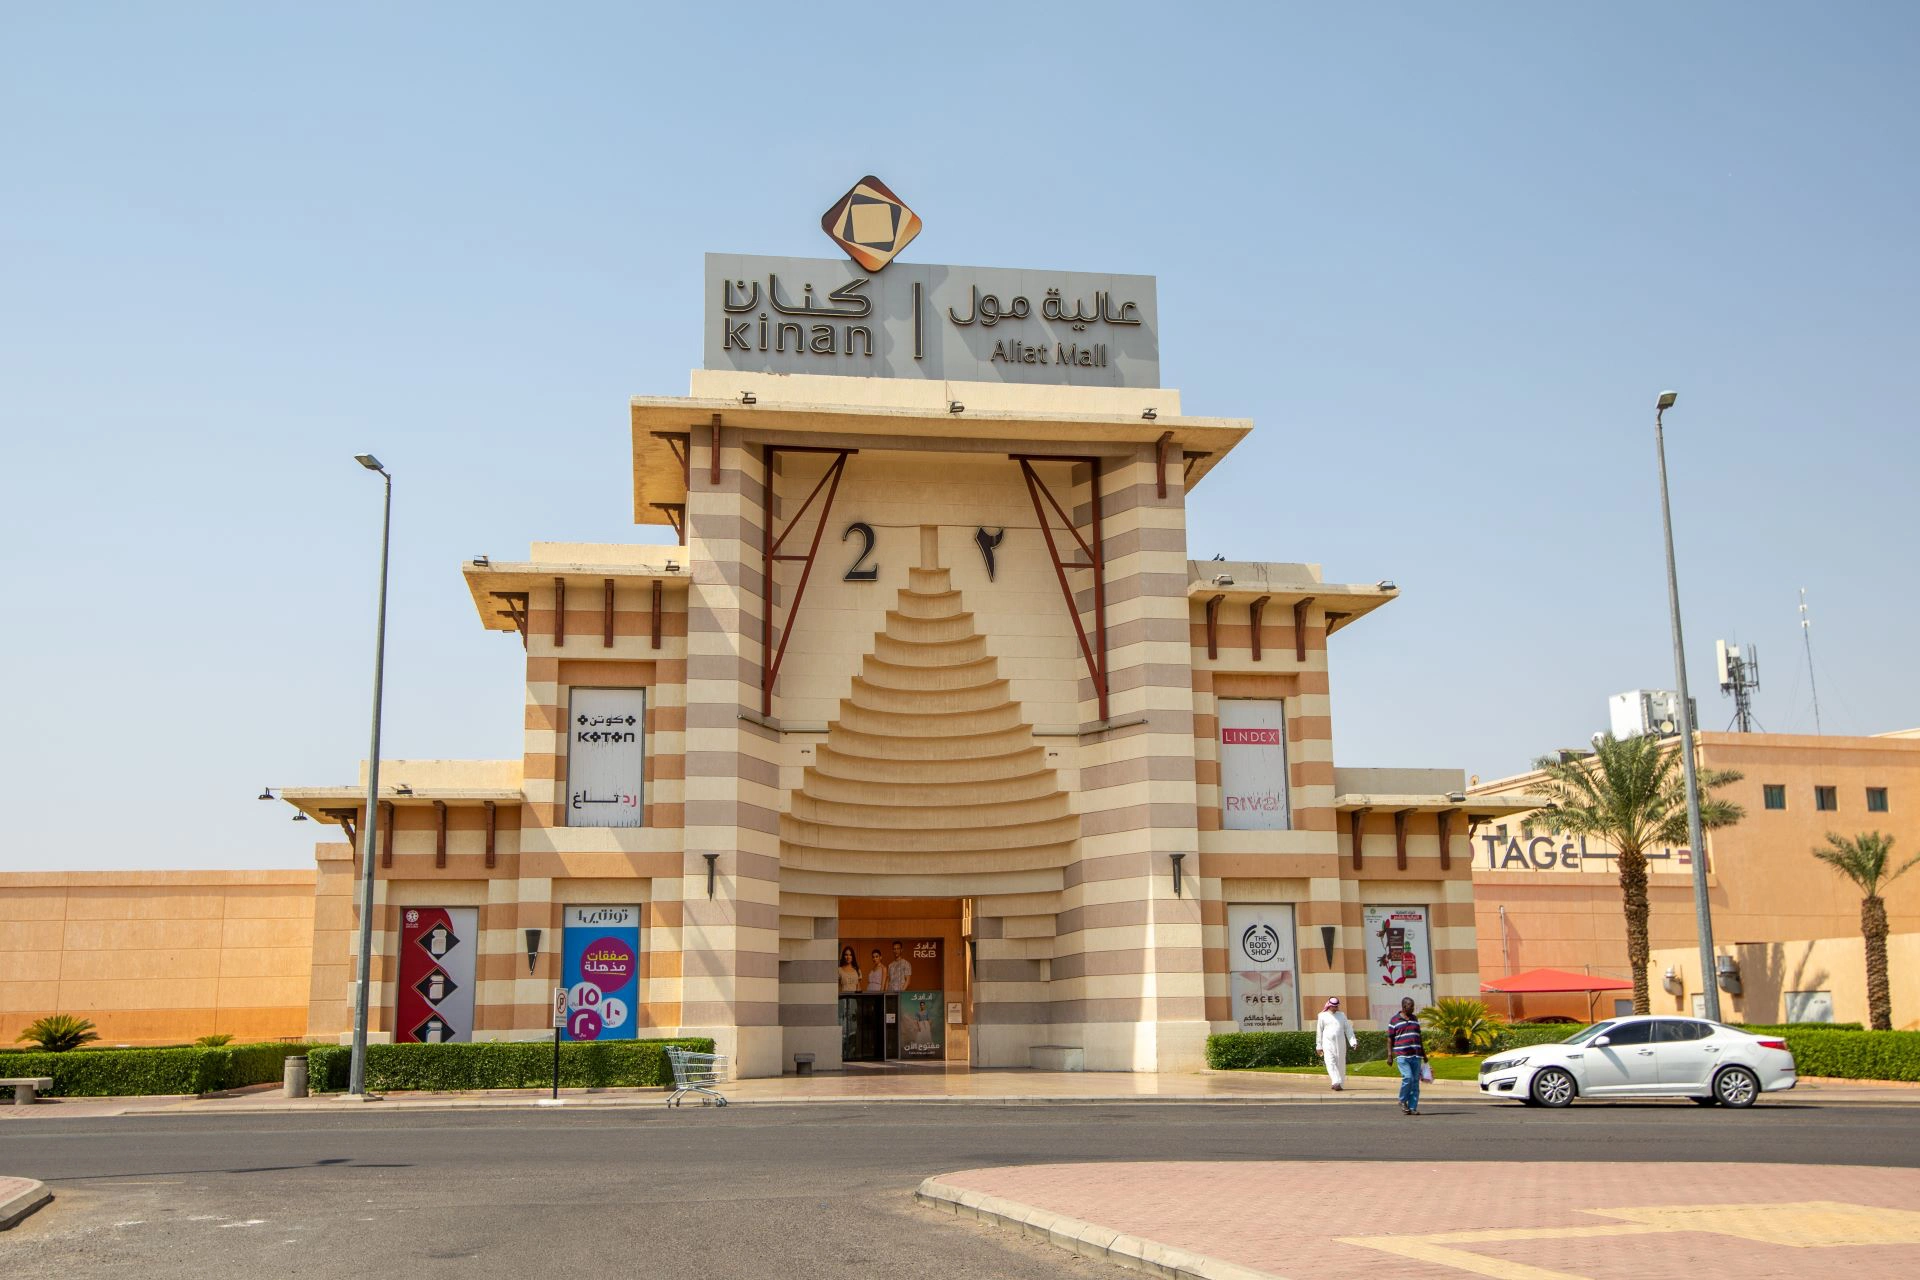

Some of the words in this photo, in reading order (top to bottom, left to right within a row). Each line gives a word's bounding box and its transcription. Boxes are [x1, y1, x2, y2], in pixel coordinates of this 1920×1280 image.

[723, 273, 873, 317] كنان
[948, 284, 1032, 327] مول
[1042, 288, 1142, 331] عالية
[723, 312, 873, 356] kinan
[990, 338, 1049, 364] Aliat
[1055, 342, 1109, 368] Mall
[843, 522, 879, 582] 2
[974, 526, 1004, 583] ٢
[589, 715, 624, 726] كوتن
[1225, 732, 1276, 742] LINDEX
[1482, 834, 1558, 869] TAG
[584, 961, 626, 972] مذهلة
[587, 950, 629, 961] صفقات
[913, 950, 937, 959] R&B
